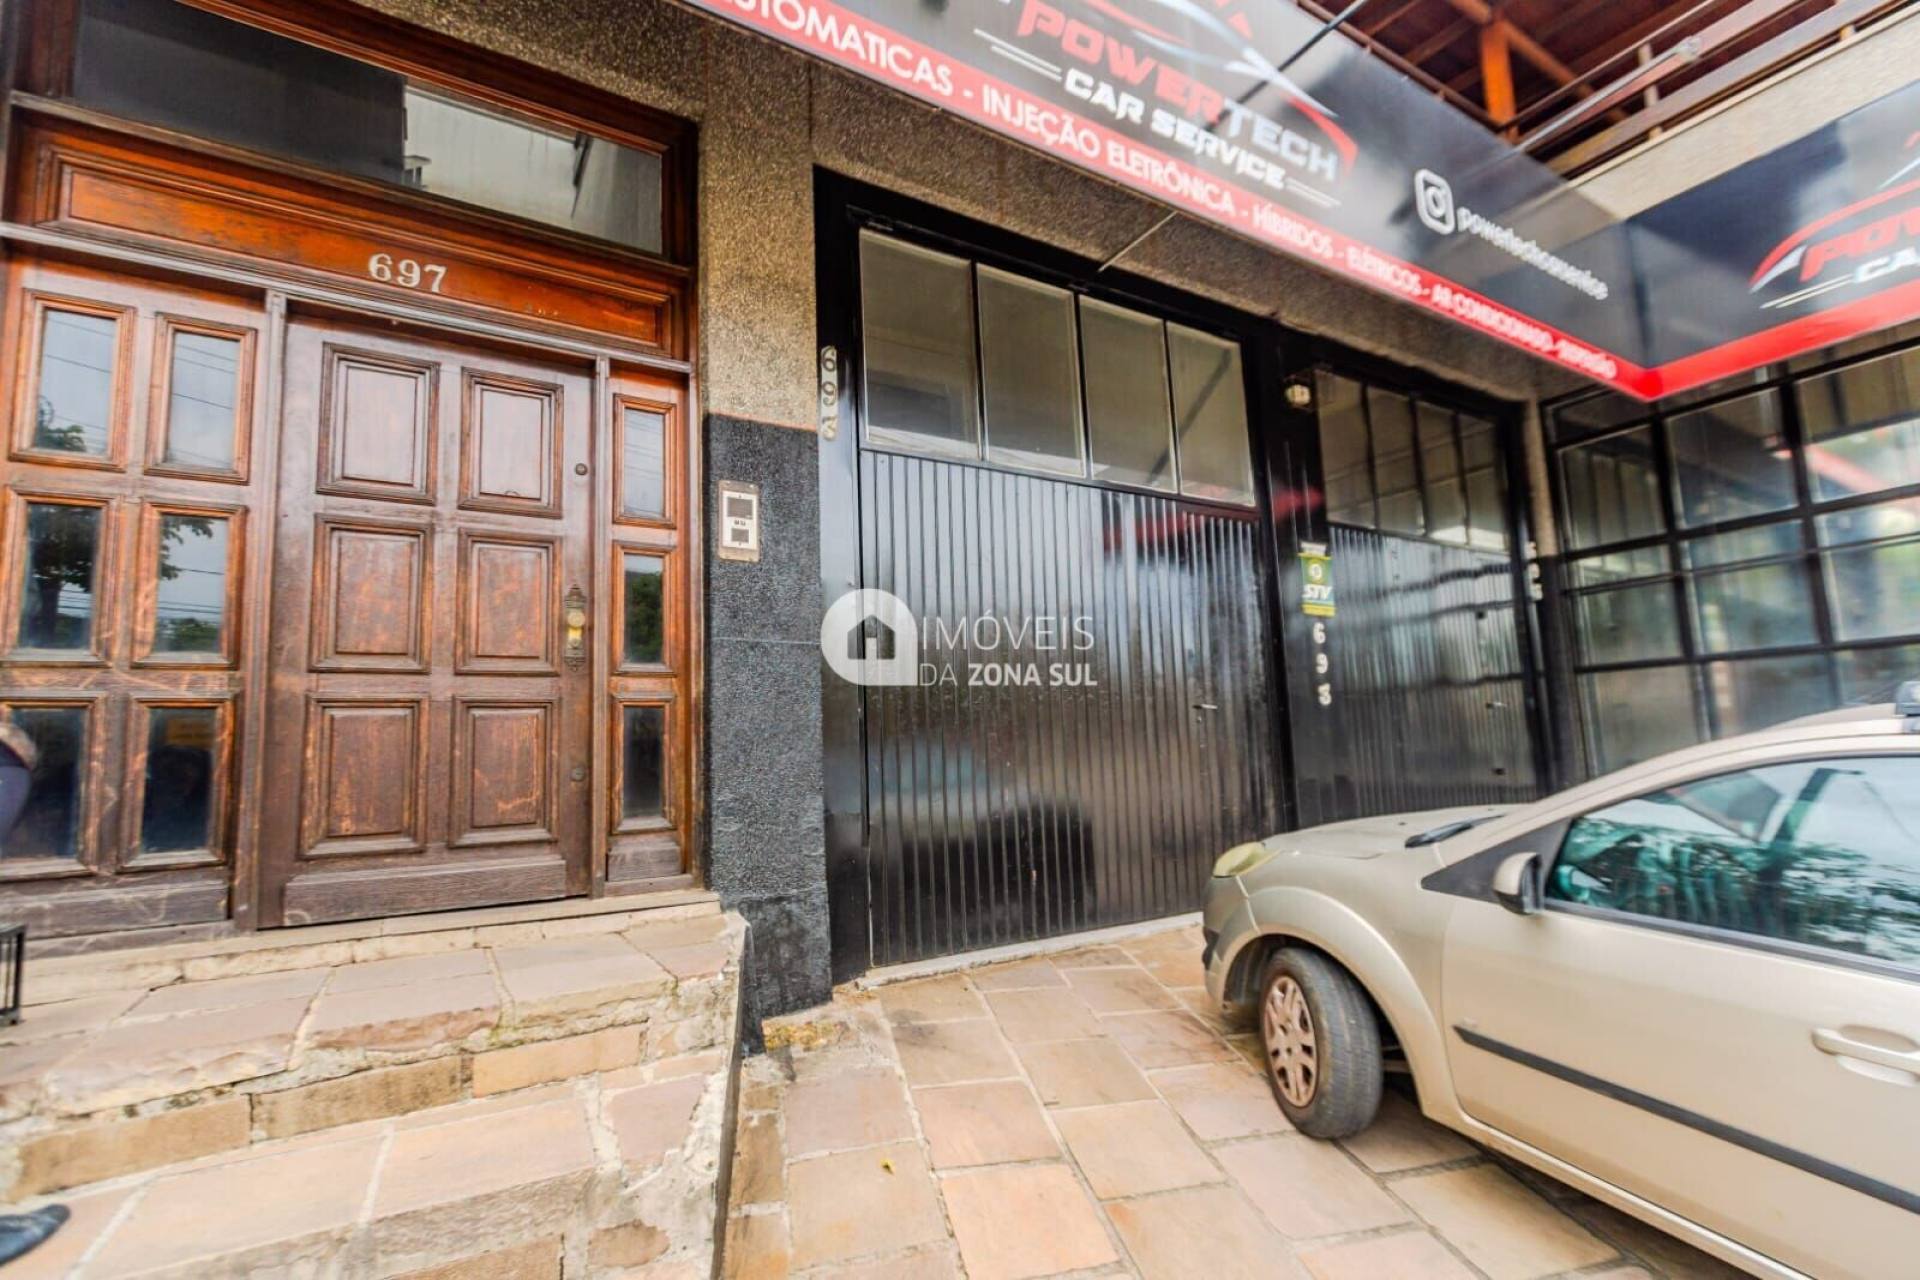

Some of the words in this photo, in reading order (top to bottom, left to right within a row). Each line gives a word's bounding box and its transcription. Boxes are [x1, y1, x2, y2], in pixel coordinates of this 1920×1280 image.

[733, 0, 953, 97] TOMATICAS
[982, 86, 1100, 159] INJEÇÃO
[1105, 140, 1237, 218] ELETRÔNICA
[1016, 0, 1339, 183] POWERTECH
[1063, 67, 1146, 125] CAR
[1150, 107, 1287, 190] SERVICE
[368, 252, 448, 294] 697
[1854, 245, 1920, 283] CA
